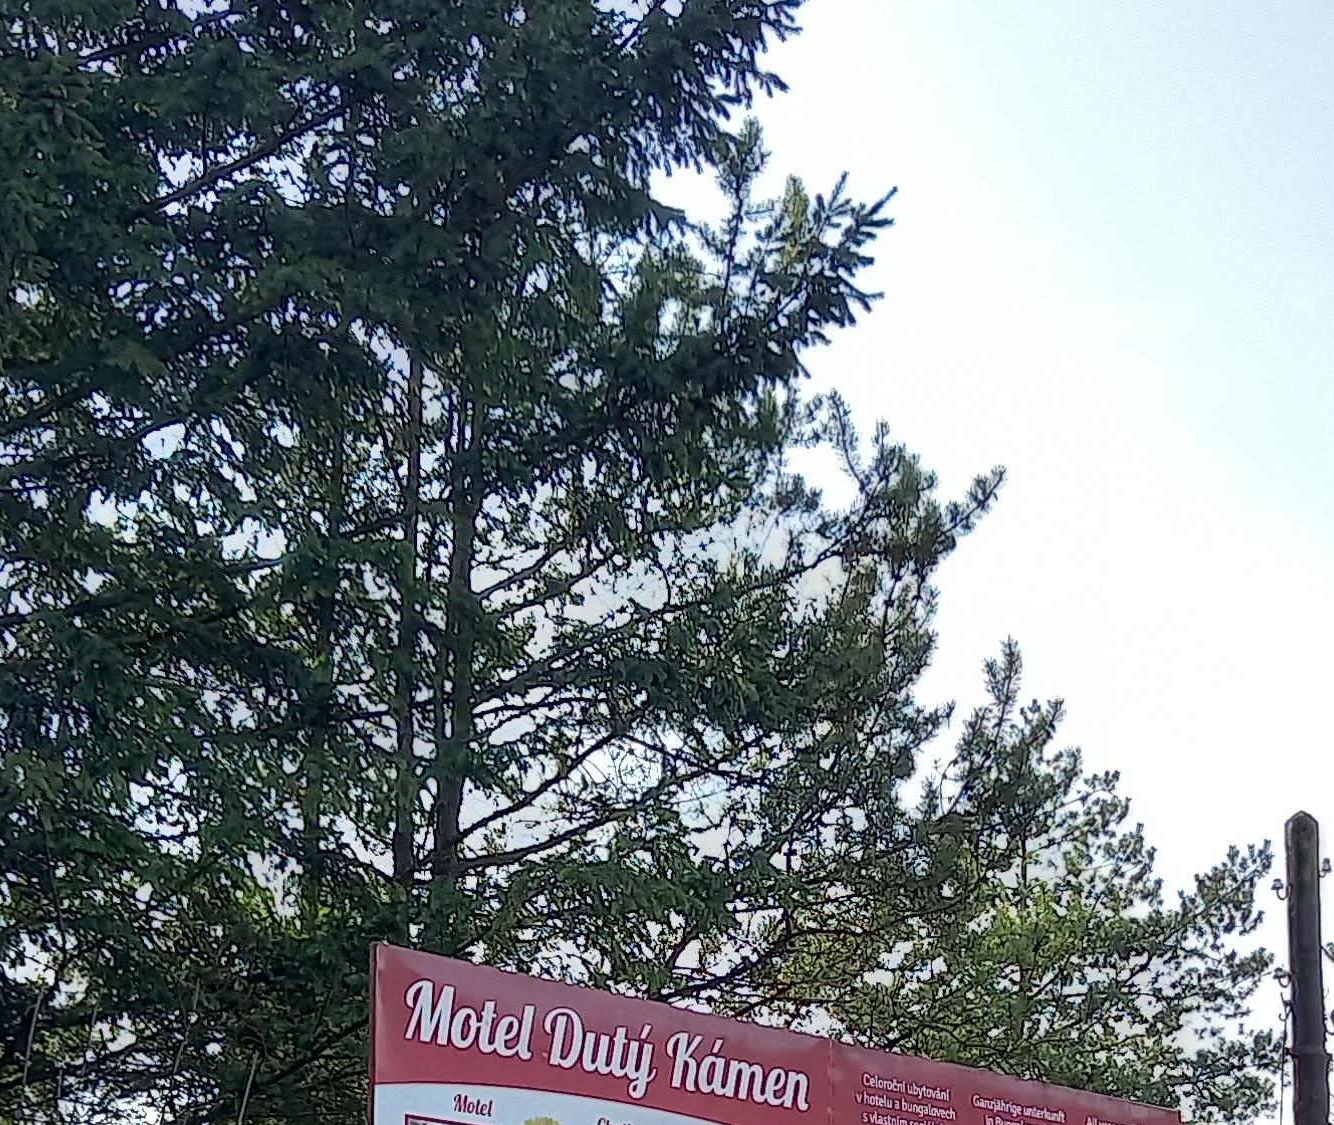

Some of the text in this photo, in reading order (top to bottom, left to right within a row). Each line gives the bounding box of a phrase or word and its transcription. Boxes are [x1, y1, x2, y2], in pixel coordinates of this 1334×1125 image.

[404, 980, 810, 1111] Motel Dutý Kámen
[862, 1073, 950, 1101] Celoroční ubytování
[453, 1094, 493, 1117] Motel
[856, 1091, 957, 1120] v hotelu a bungalovech
[862, 1113, 868, 1122] s
[972, 1095, 1066, 1123] Ganzjährige unterkunft
